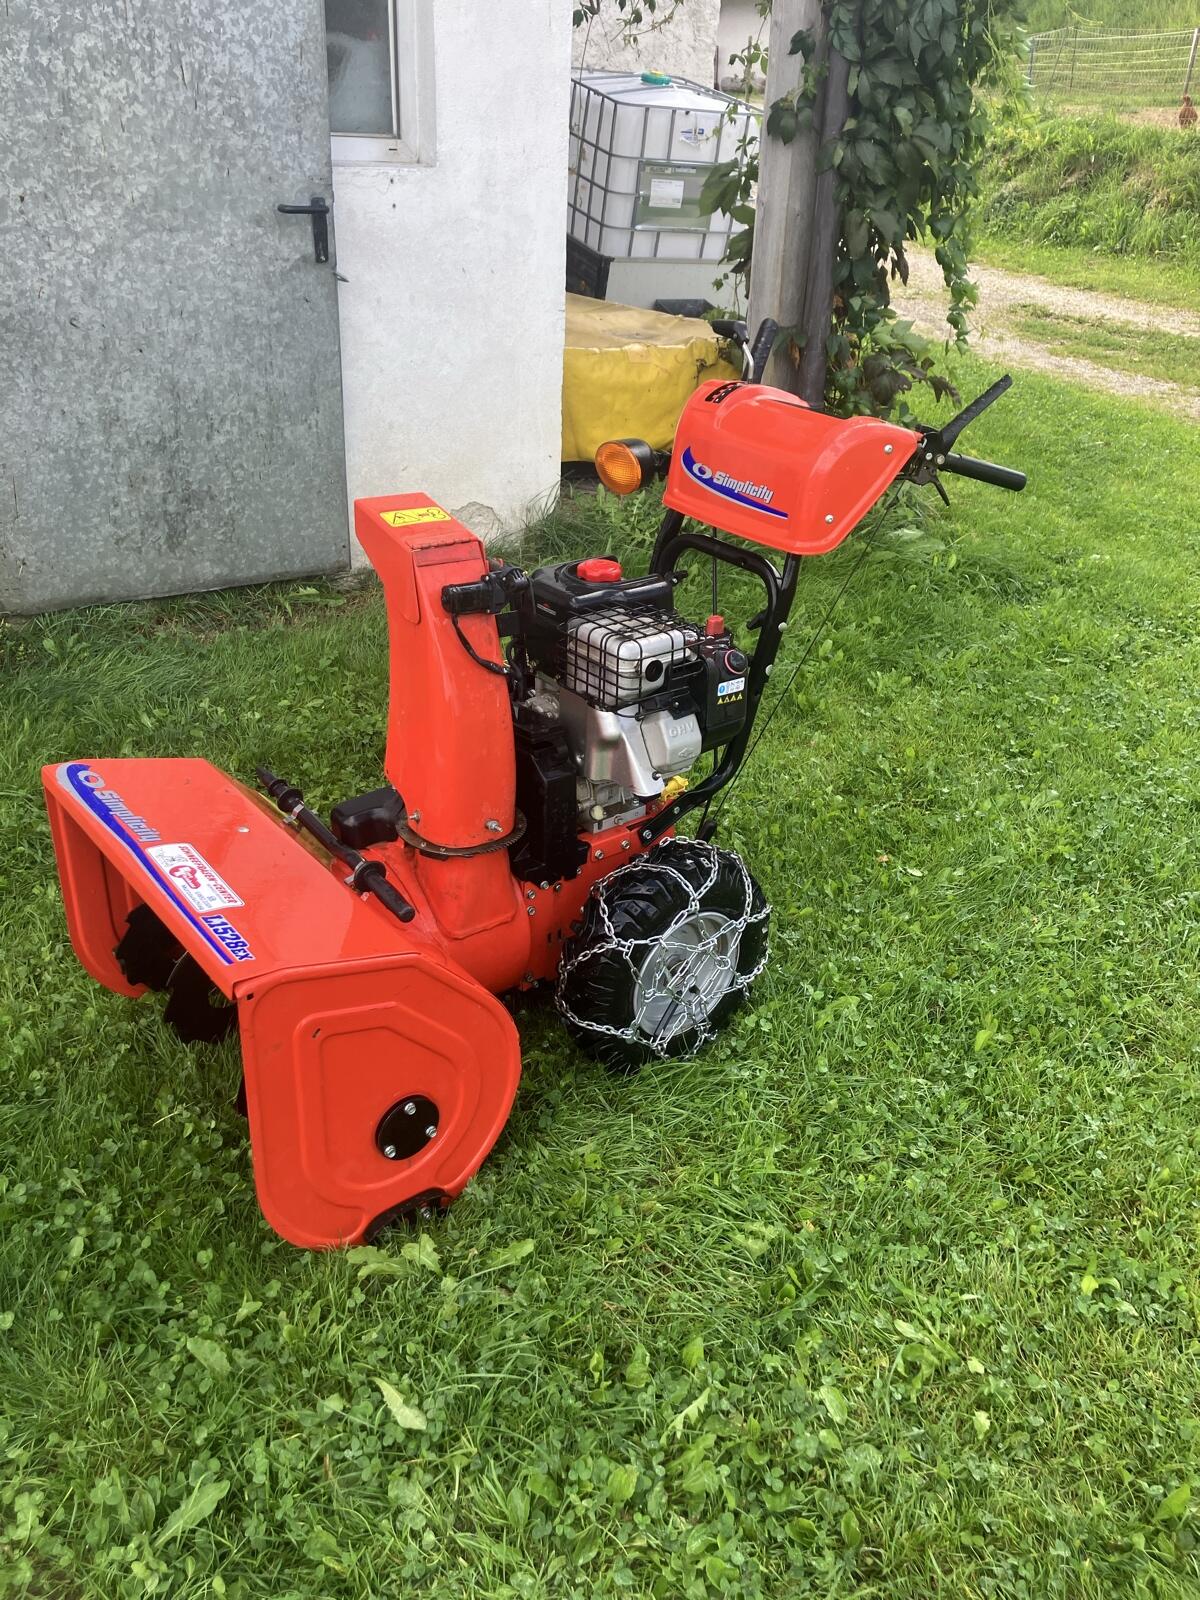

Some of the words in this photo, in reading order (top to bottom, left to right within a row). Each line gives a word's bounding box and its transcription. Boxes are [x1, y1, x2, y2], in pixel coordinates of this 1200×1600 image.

[713, 470, 775, 504] Simplicity
[669, 720, 696, 738] OHV
[93, 790, 162, 842] Simplicity
